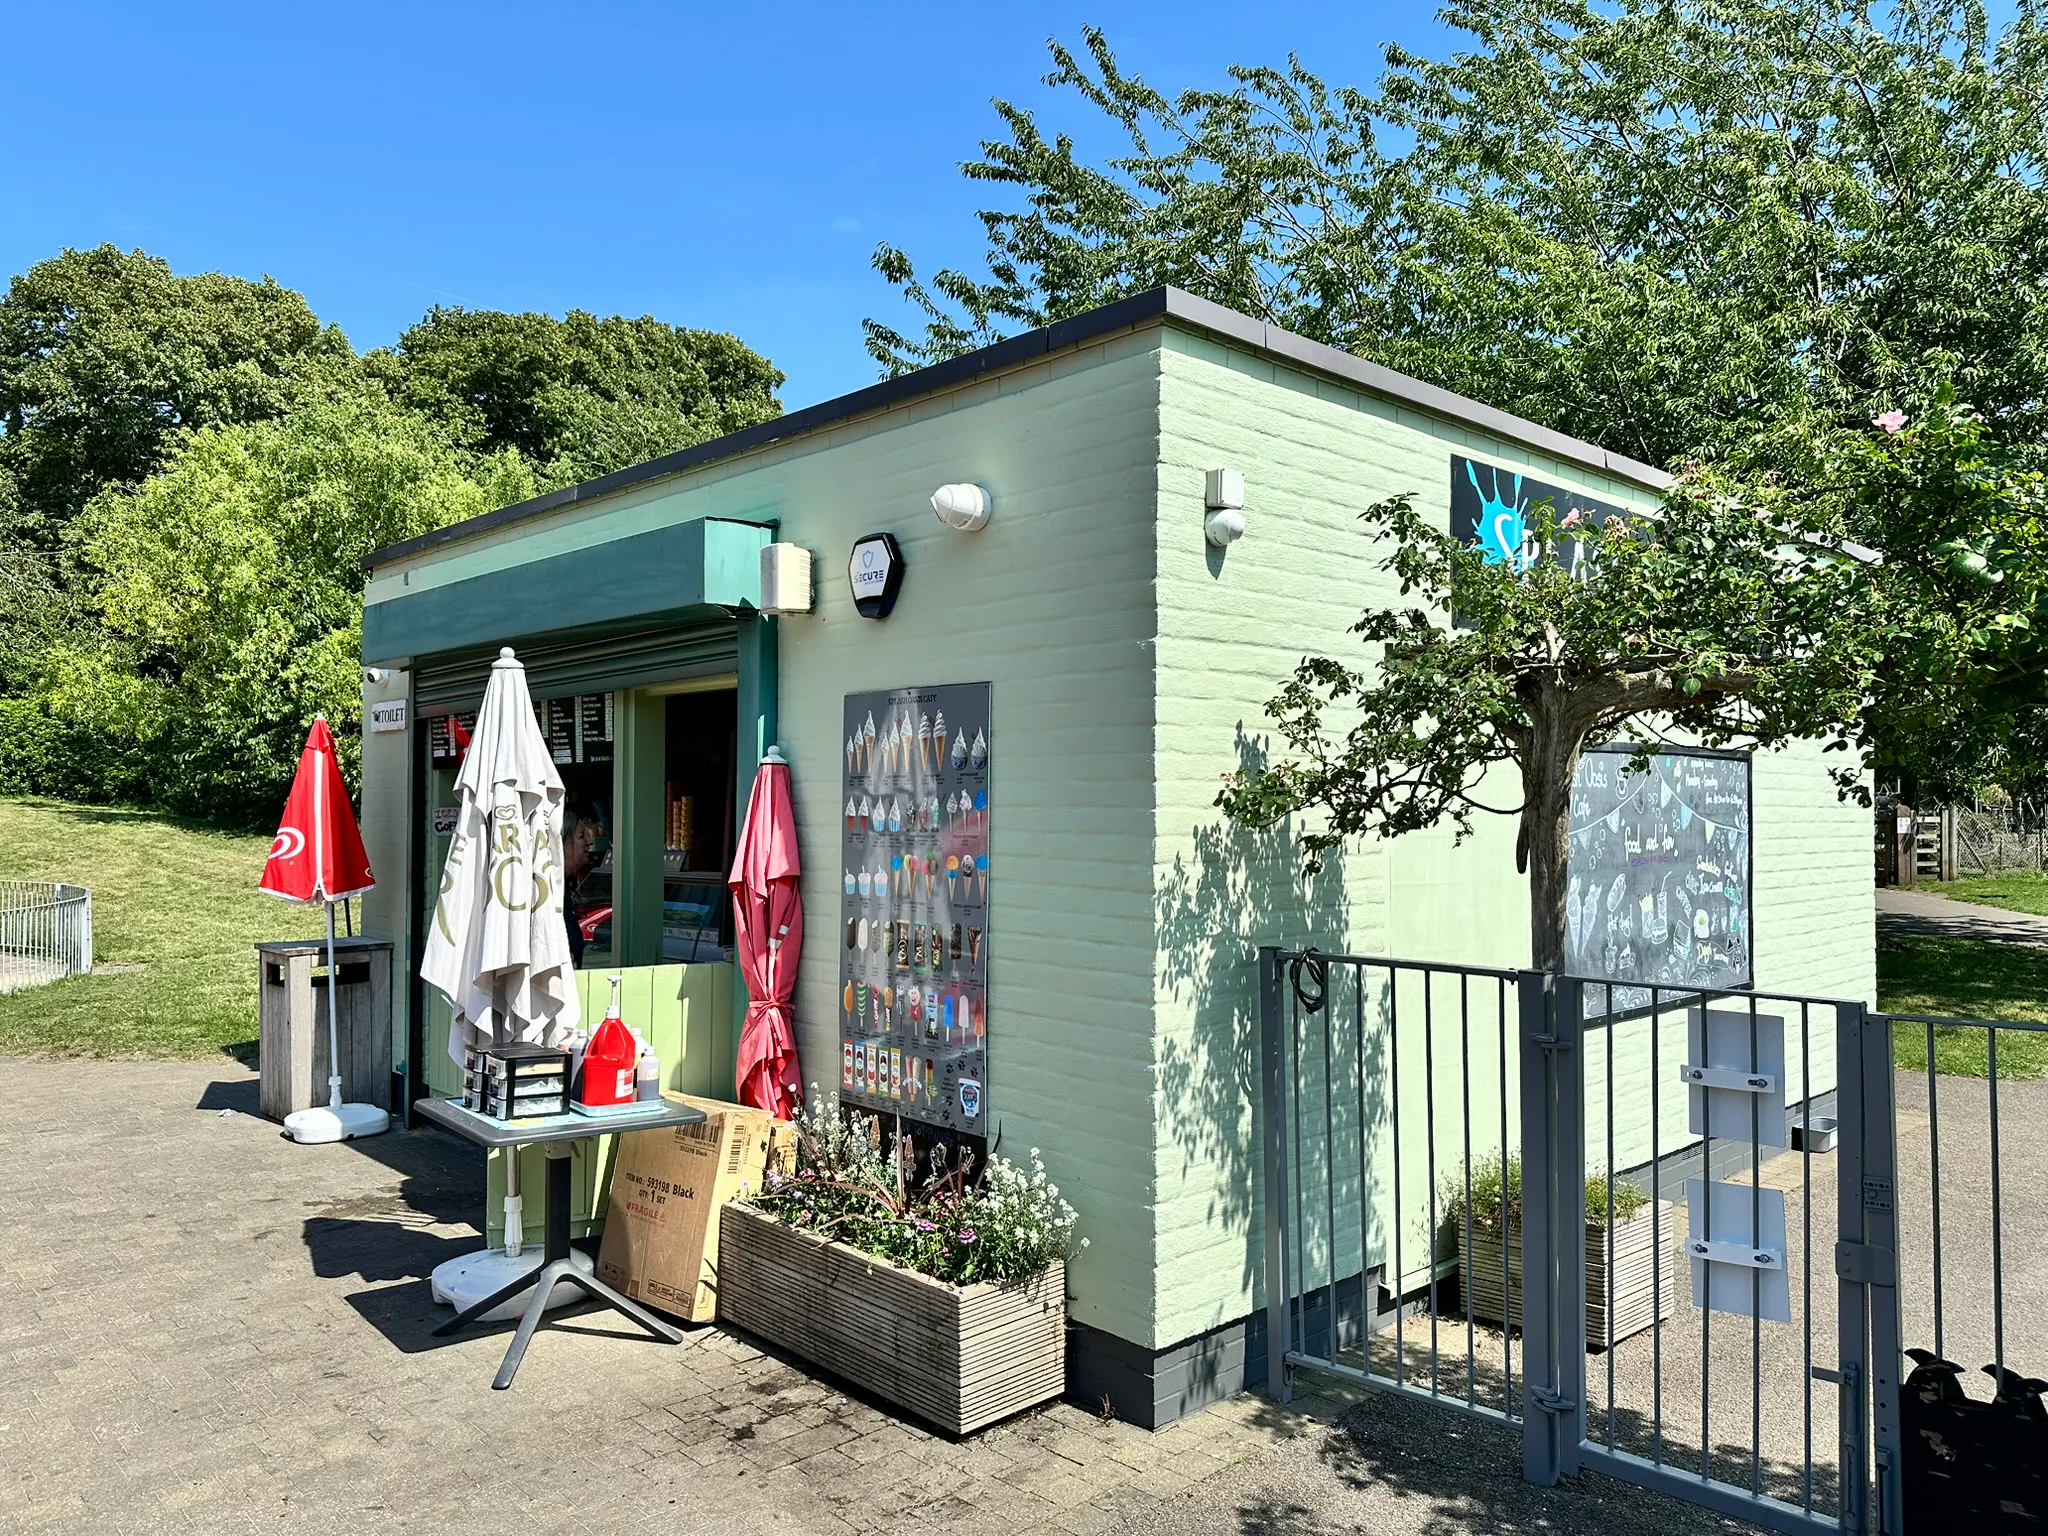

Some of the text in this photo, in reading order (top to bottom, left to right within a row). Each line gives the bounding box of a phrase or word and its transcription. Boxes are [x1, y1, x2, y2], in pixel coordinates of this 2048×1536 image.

[854, 569, 884, 583] SECURE
[380, 708, 404, 723] TOILET
[1585, 757, 1608, 788] Oasis
[1573, 793, 1591, 821] Cafe
[1624, 823, 1675, 861] food and fun
[626, 1172, 636, 1183] ITEM
[646, 1176, 670, 1194] 593198
[672, 1184, 694, 1200] Black
[638, 1188, 666, 1205] QTY: 1 SET
[631, 1203, 659, 1219] FRAGILE
